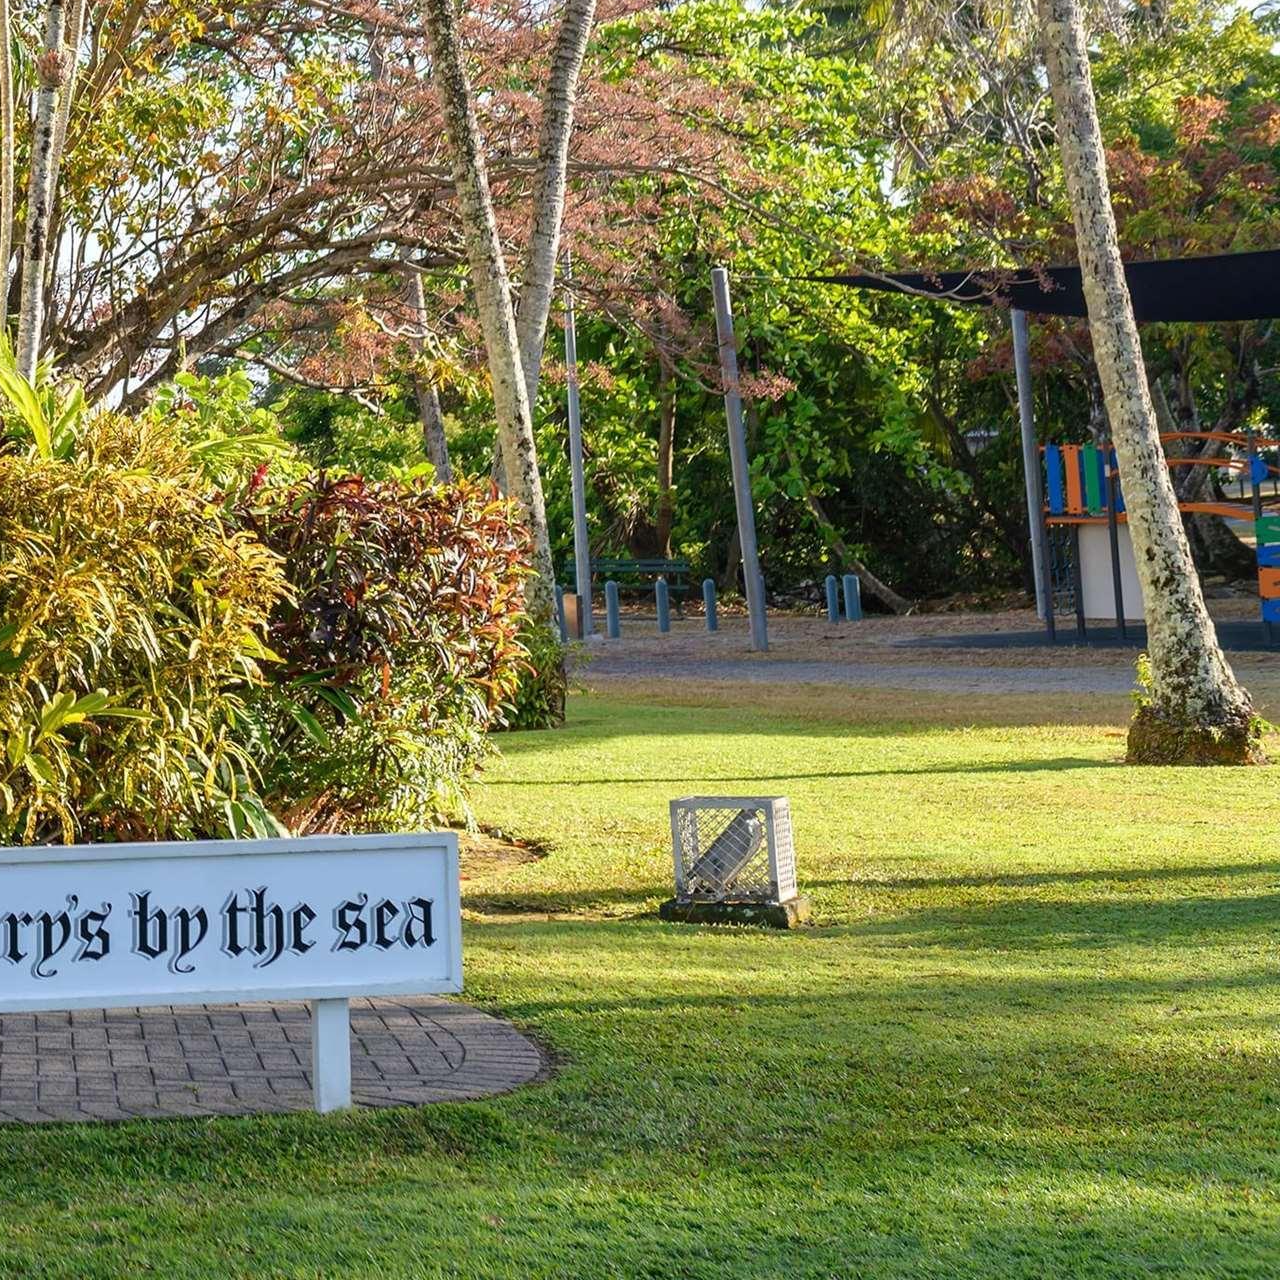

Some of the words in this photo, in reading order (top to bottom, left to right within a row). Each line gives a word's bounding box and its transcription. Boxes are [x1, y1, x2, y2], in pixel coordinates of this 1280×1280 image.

[128, 889, 208, 975] by
[219, 885, 318, 969] the
[329, 892, 438, 953] sea
